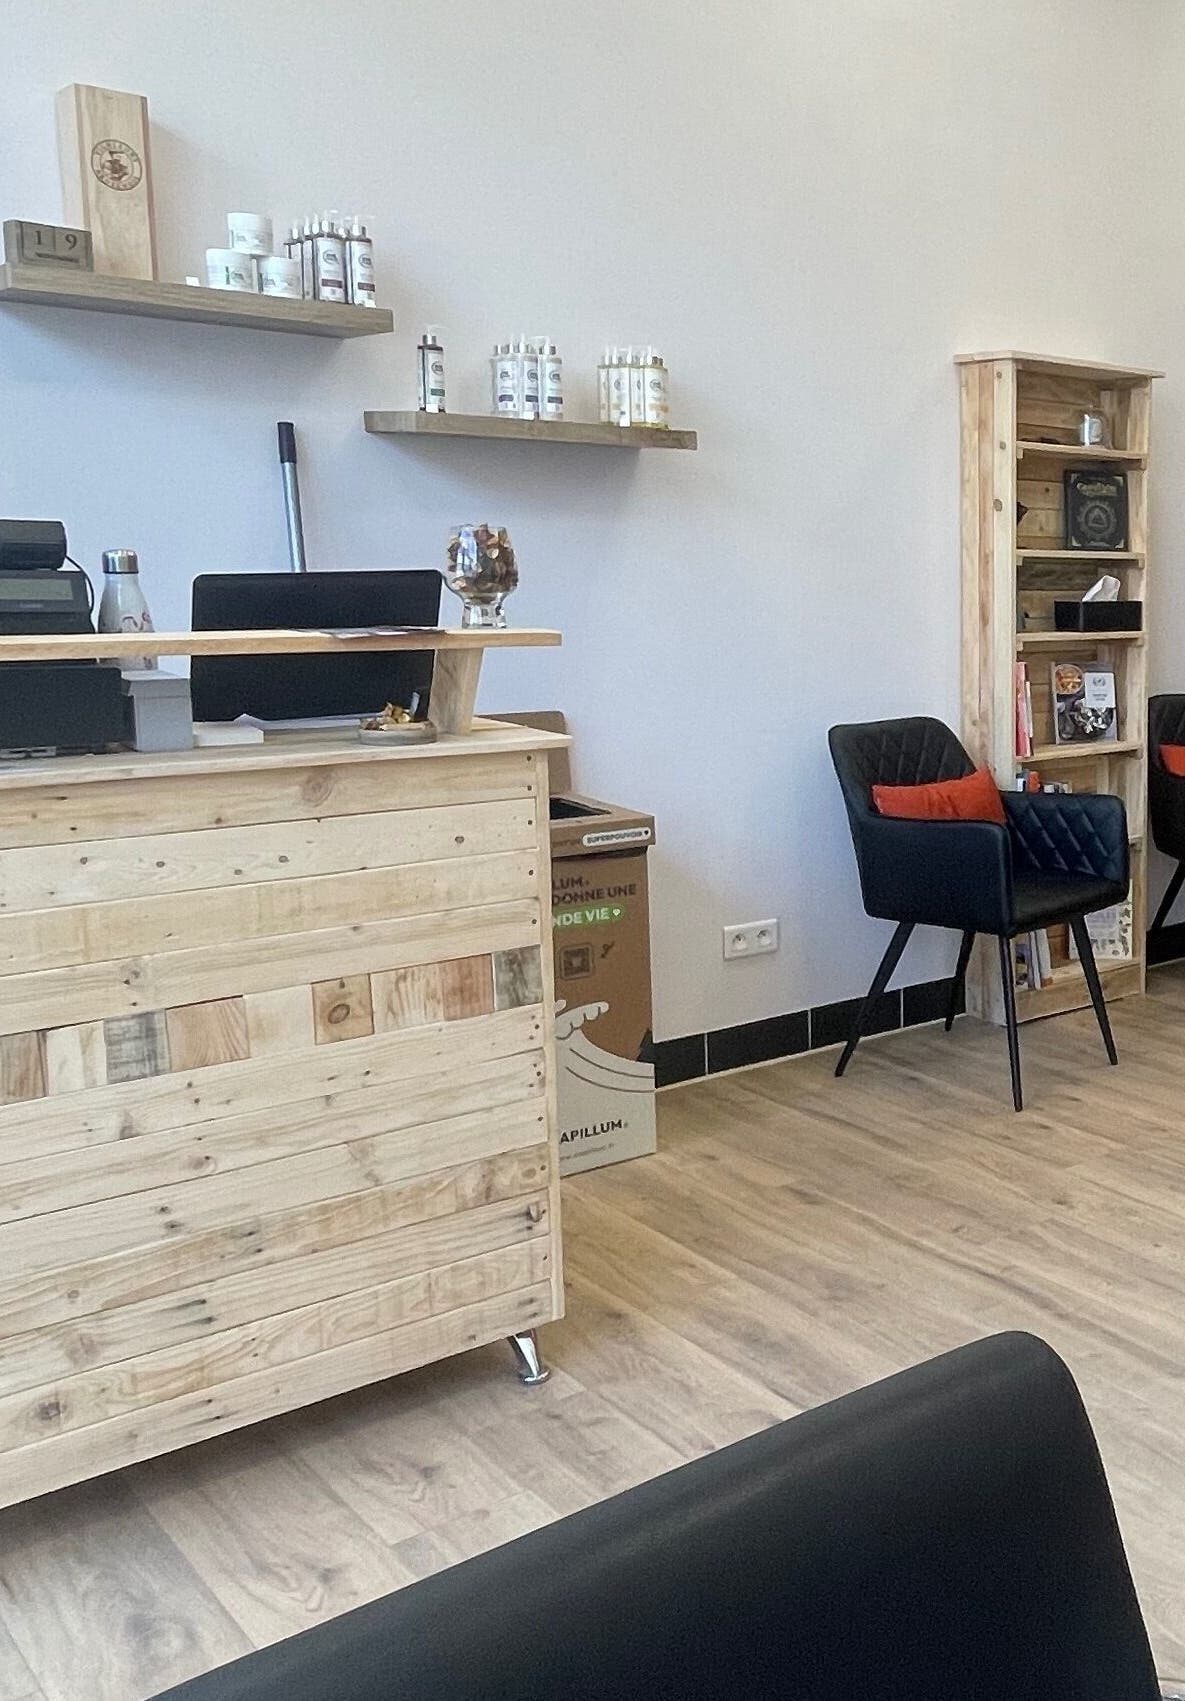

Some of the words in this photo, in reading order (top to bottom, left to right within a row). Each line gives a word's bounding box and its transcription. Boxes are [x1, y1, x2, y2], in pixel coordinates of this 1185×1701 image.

[64, 233, 78, 250] 9
[607, 884, 637, 898] UNE
[552, 911, 583, 926] NDE
[585, 907, 611, 921] VIE
